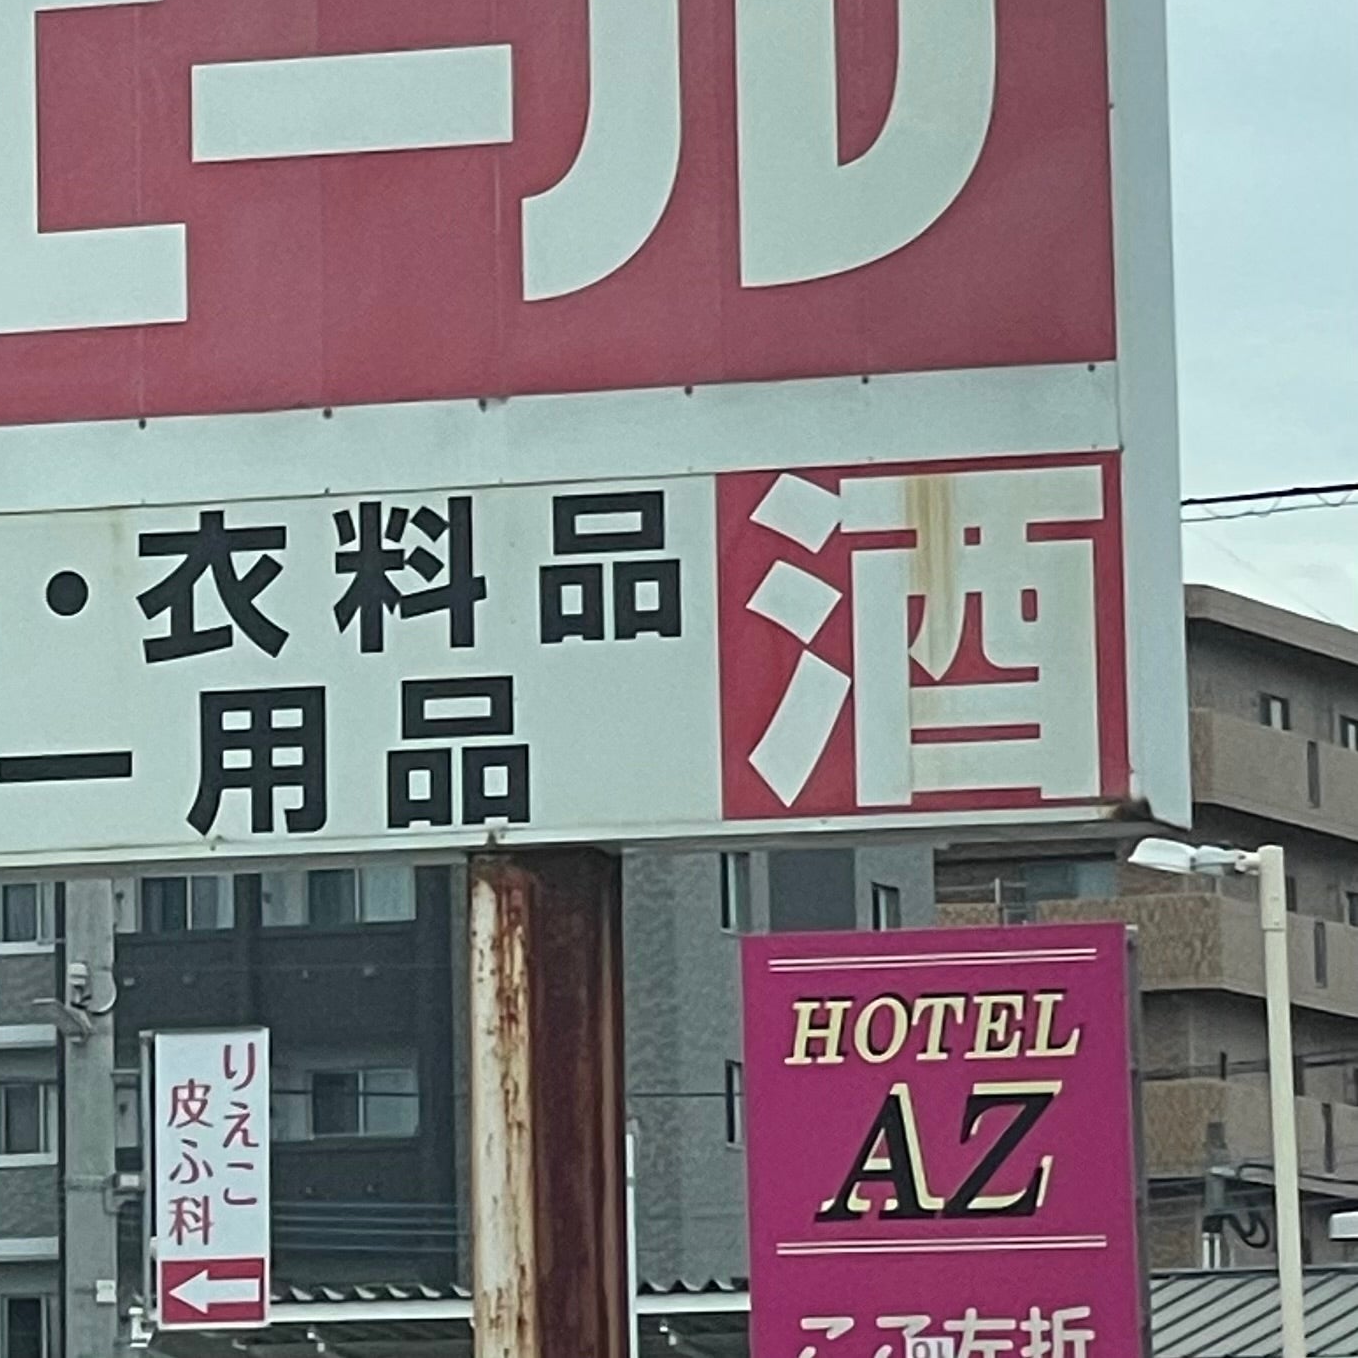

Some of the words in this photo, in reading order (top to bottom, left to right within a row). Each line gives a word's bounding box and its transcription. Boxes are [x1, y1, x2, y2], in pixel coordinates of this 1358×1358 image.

[747, 464, 1104, 808] 酒
[784, 991, 1082, 1065] HOTEL
[166, 1078, 215, 1246] 皮ふ科
[222, 1041, 260, 1206] りえこ
[814, 1080, 1063, 1223] AZ
